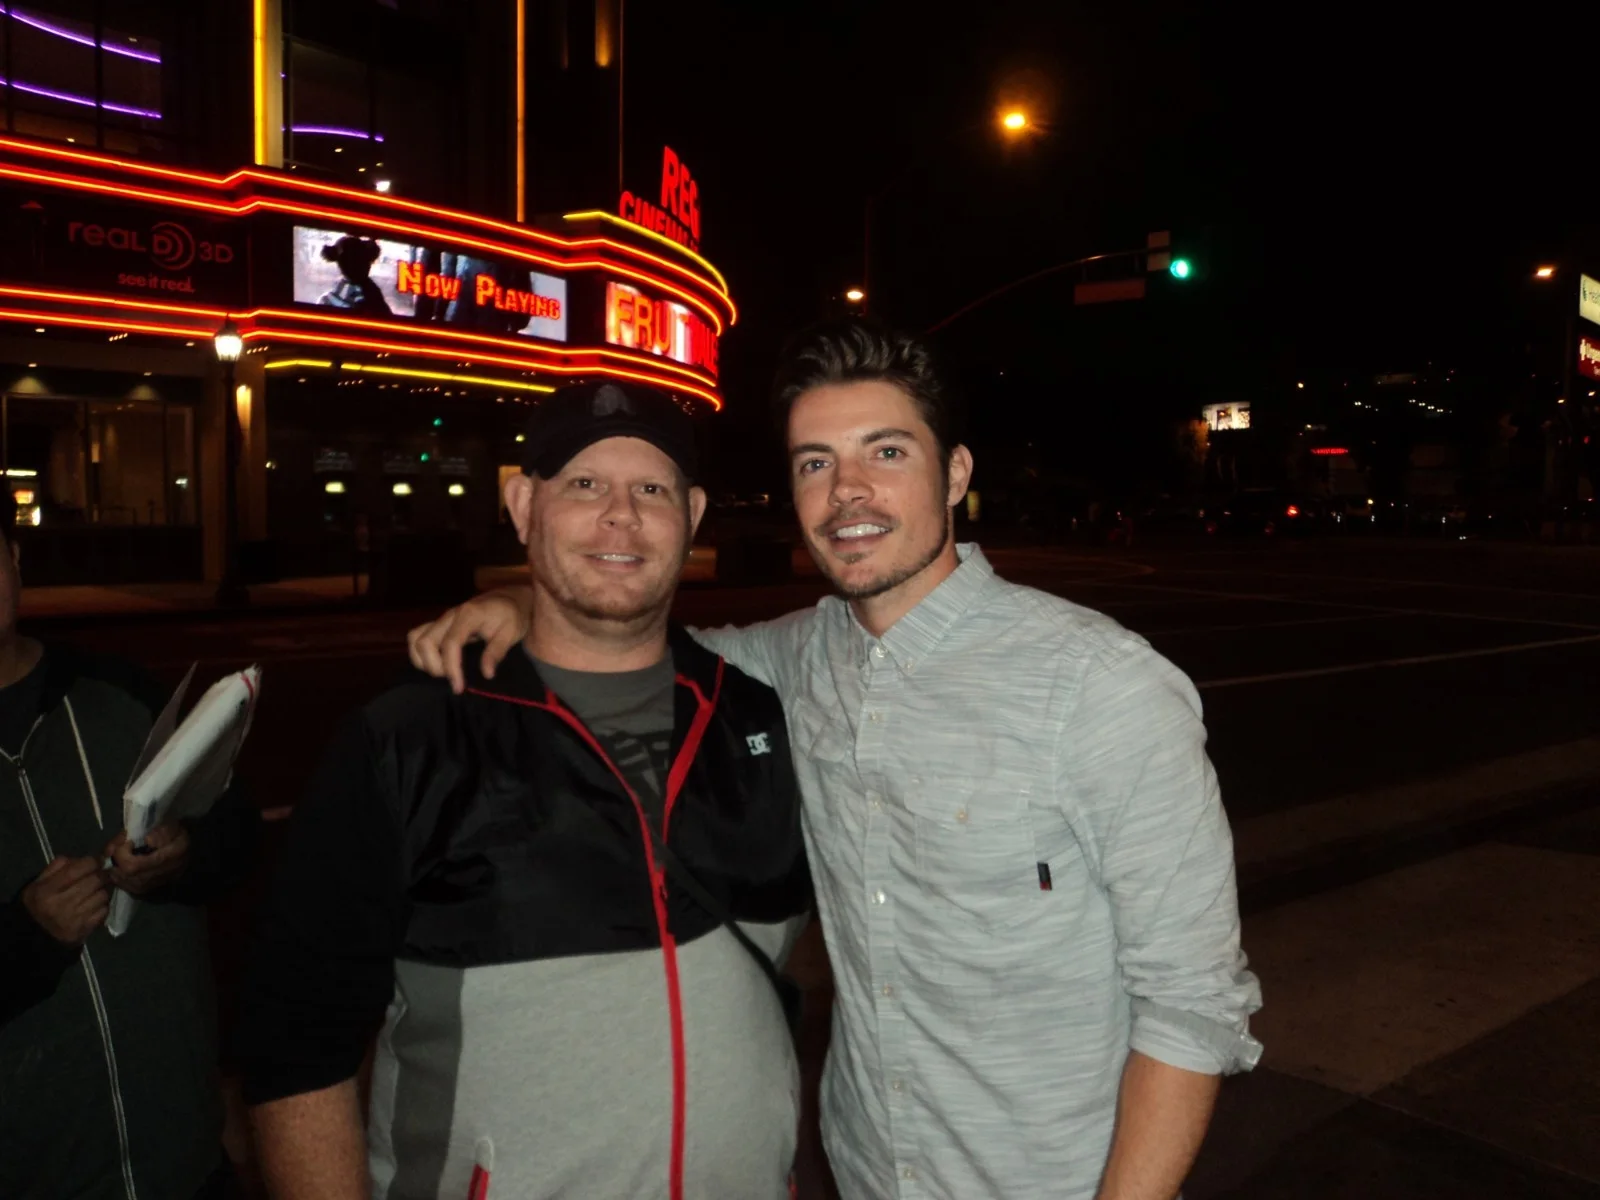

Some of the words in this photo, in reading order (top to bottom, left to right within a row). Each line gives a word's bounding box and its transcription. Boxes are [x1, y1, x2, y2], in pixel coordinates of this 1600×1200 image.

[200, 242, 234, 263] 3D
[117, 274, 147, 288] see
[149, 274, 161, 289] it
